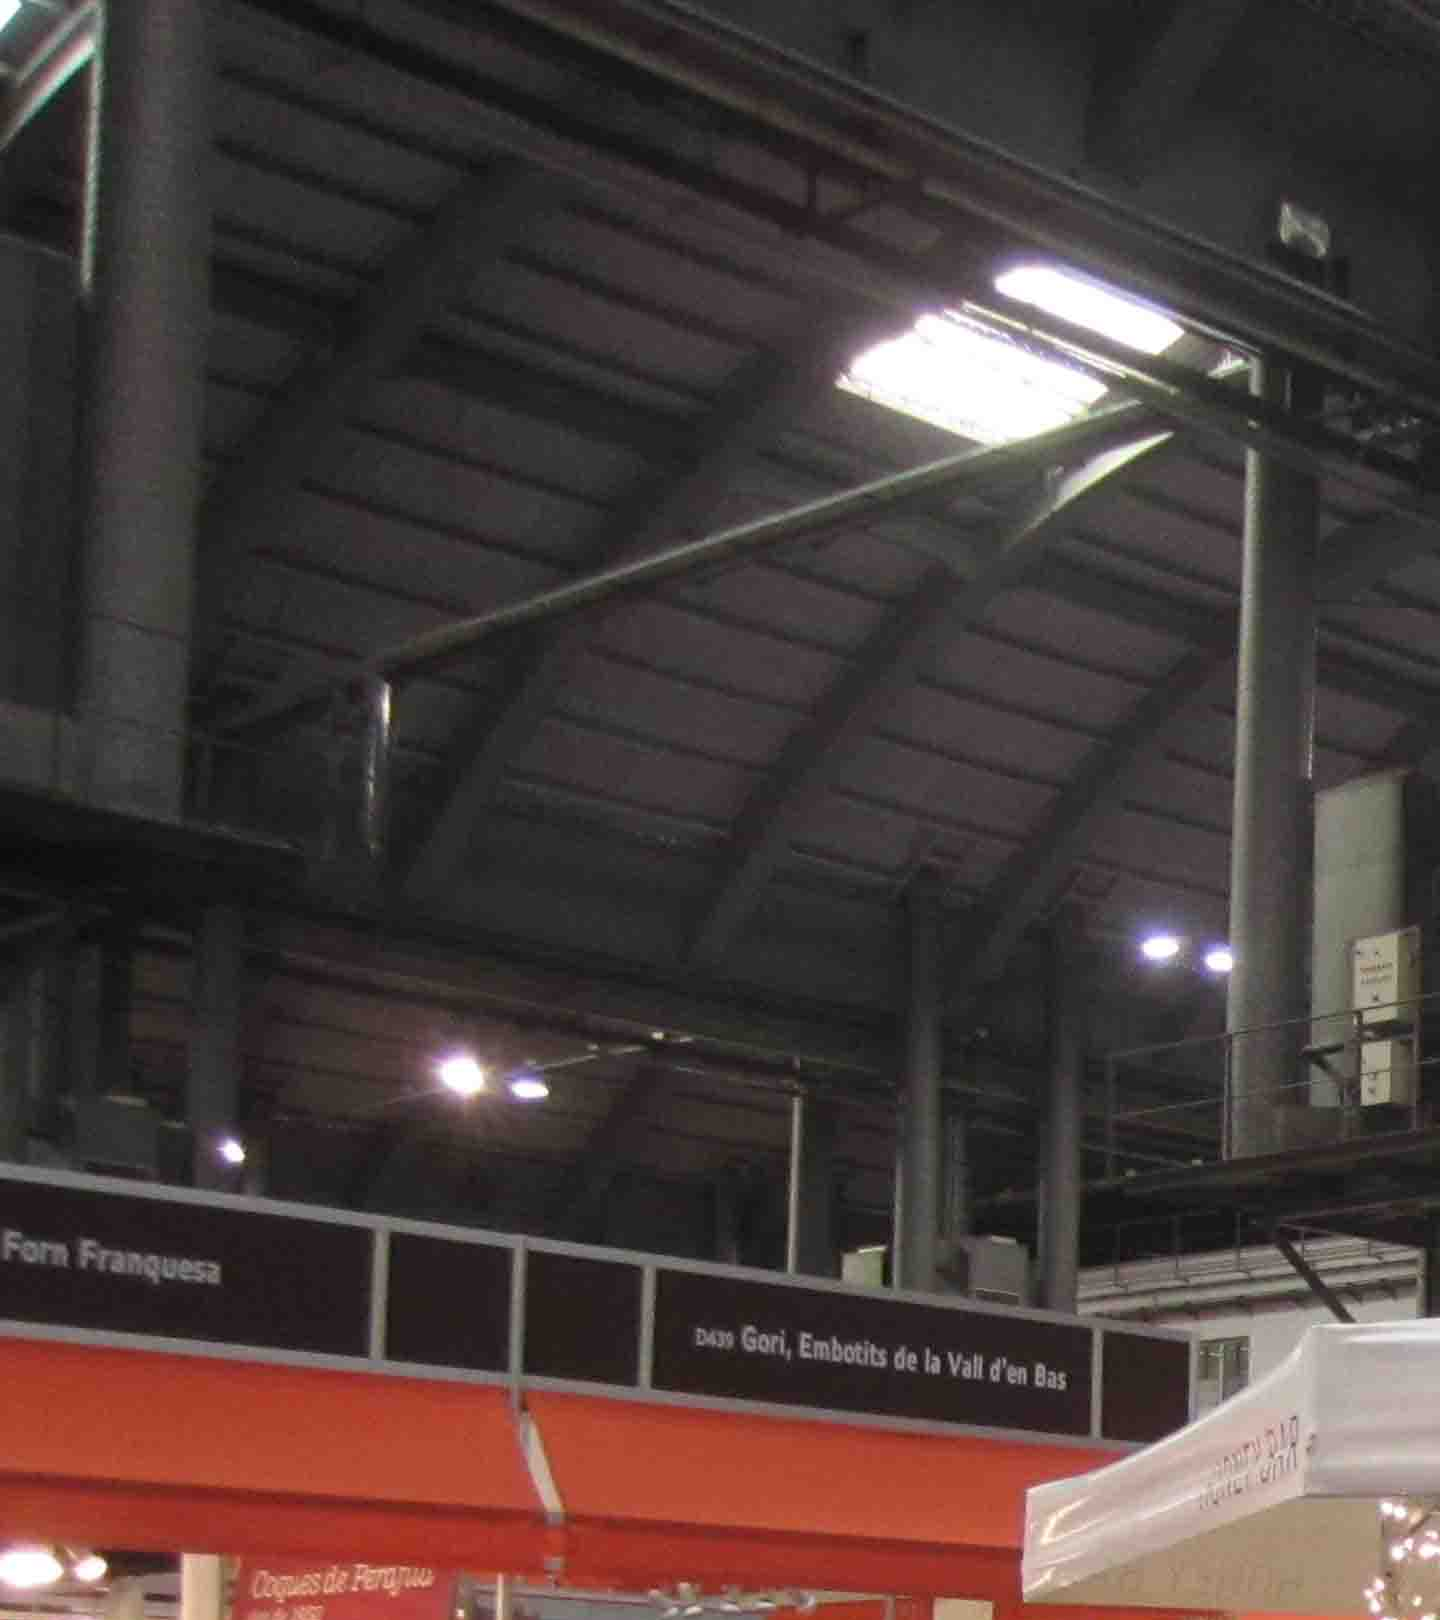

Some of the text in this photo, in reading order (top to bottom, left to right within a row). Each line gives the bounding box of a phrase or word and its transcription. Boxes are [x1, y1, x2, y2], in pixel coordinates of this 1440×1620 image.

[3, 1229, 221, 1285] Forn Franquesa
[740, 1325, 793, 1361] Gori,
[799, 1332, 888, 1370] Embotits
[893, 1345, 918, 1374] de
[924, 1347, 942, 1376] la
[946, 1351, 984, 1381] Vall
[989, 1356, 1028, 1387] d'en
[1034, 1363, 1069, 1392] Bas
